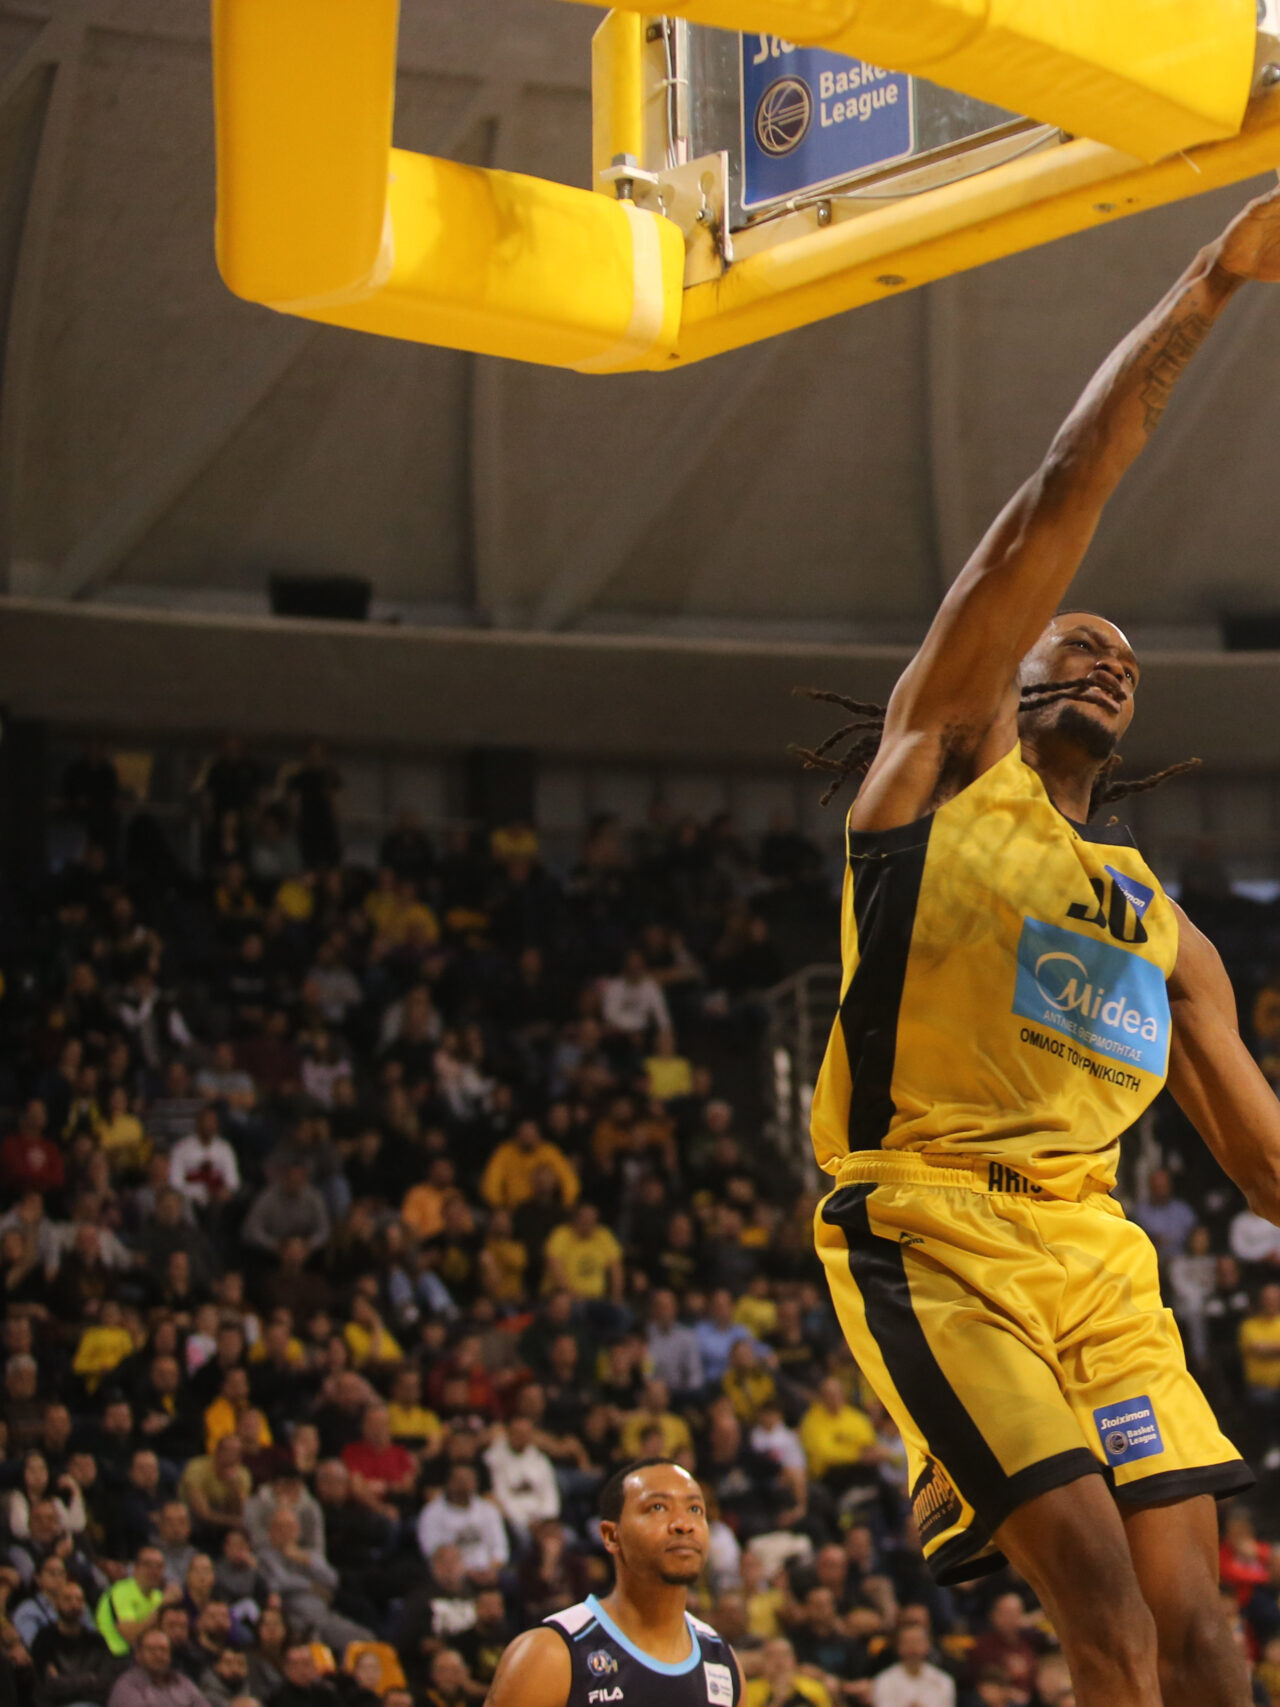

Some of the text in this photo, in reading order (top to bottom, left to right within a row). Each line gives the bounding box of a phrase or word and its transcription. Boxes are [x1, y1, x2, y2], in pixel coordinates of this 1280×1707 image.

[819, 60, 897, 99] Baske
[819, 83, 899, 127] League
[1054, 977, 1158, 1042] Midea
[1020, 1028, 1066, 1058] ΟΜΙΛΟΣ
[1126, 1424, 1155, 1438] Basket
[1129, 1433, 1157, 1446] League
[588, 1686, 624, 1704] FILA
